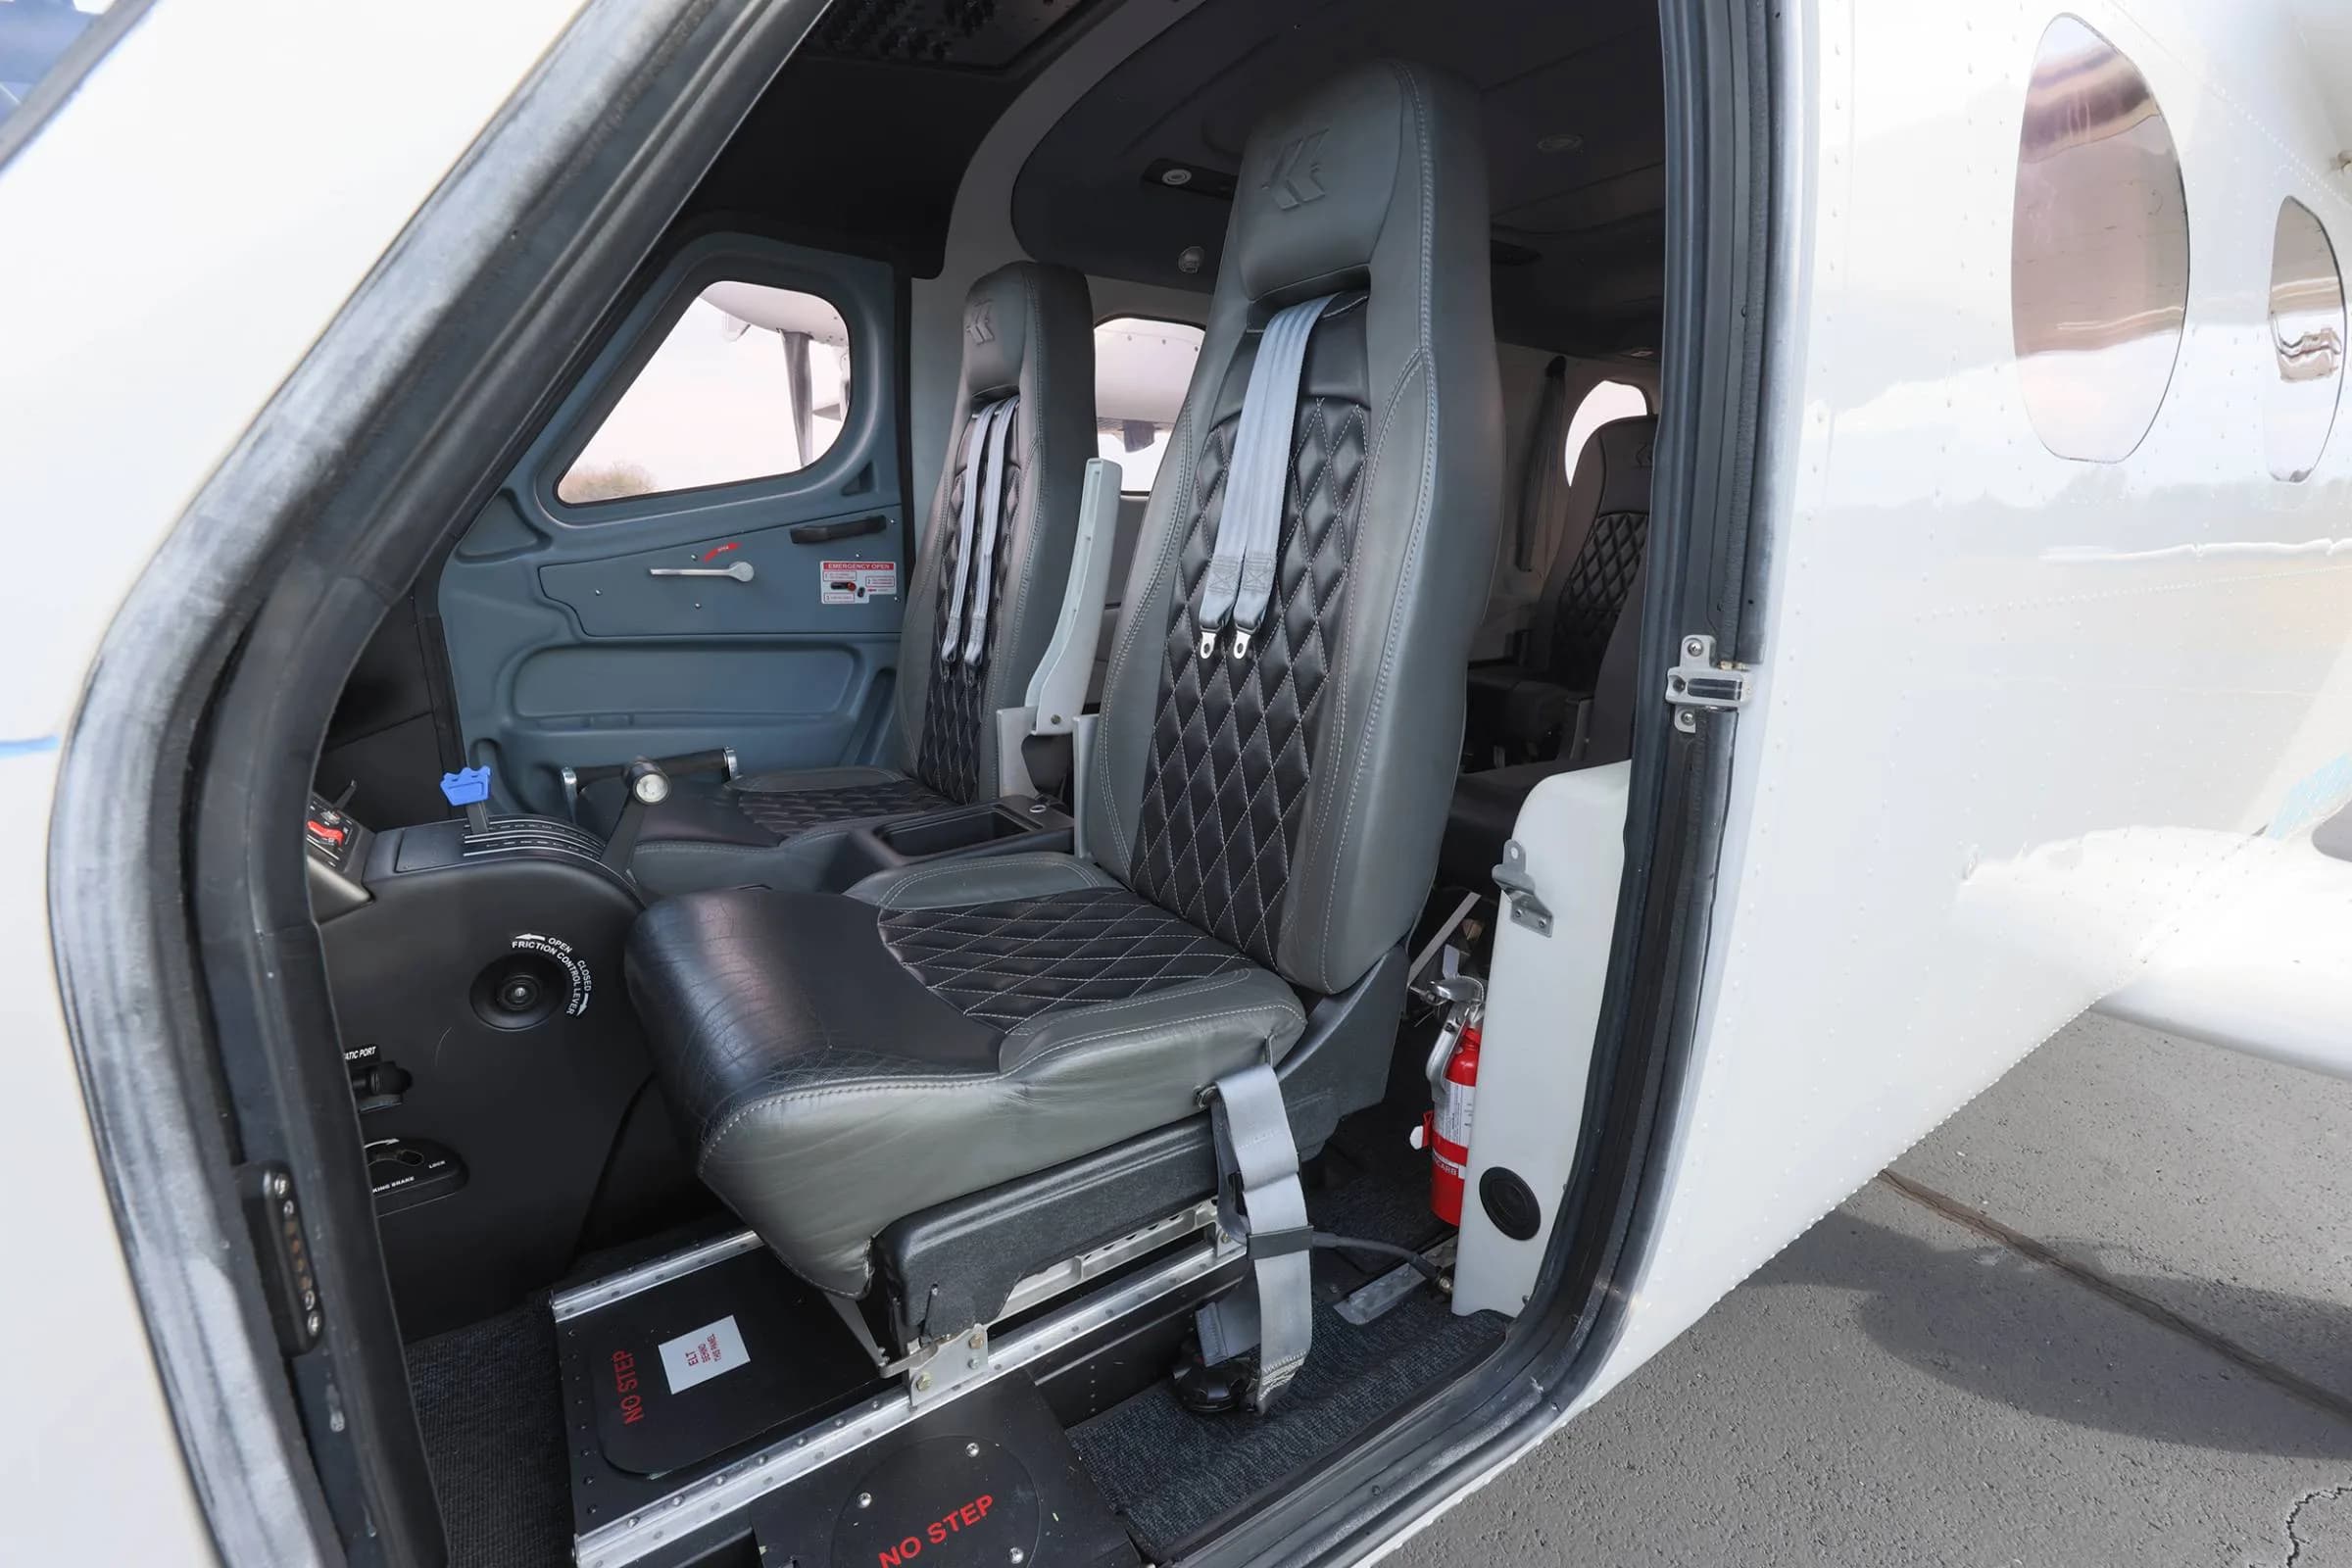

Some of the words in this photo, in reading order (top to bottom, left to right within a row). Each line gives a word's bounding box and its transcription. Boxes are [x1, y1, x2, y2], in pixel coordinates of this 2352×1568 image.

[512, 941, 558, 956] FRICTION
[548, 937, 573, 954] OPEN
[557, 952, 581, 987] CONTROL
[577, 959, 592, 992] CLOSED
[566, 988, 581, 1015] LEVER
[344, 1051, 359, 1060] ATIC
[359, 1046, 377, 1058] PORT
[372, 1184, 391, 1194] KING
[391, 1176, 415, 1188] BRAKE
[612, 1349, 638, 1394] STEP
[685, 1350, 699, 1366] ELT
[620, 1394, 644, 1425] NO
[878, 1536, 922, 1568] NO
[926, 1494, 994, 1544] STEP
